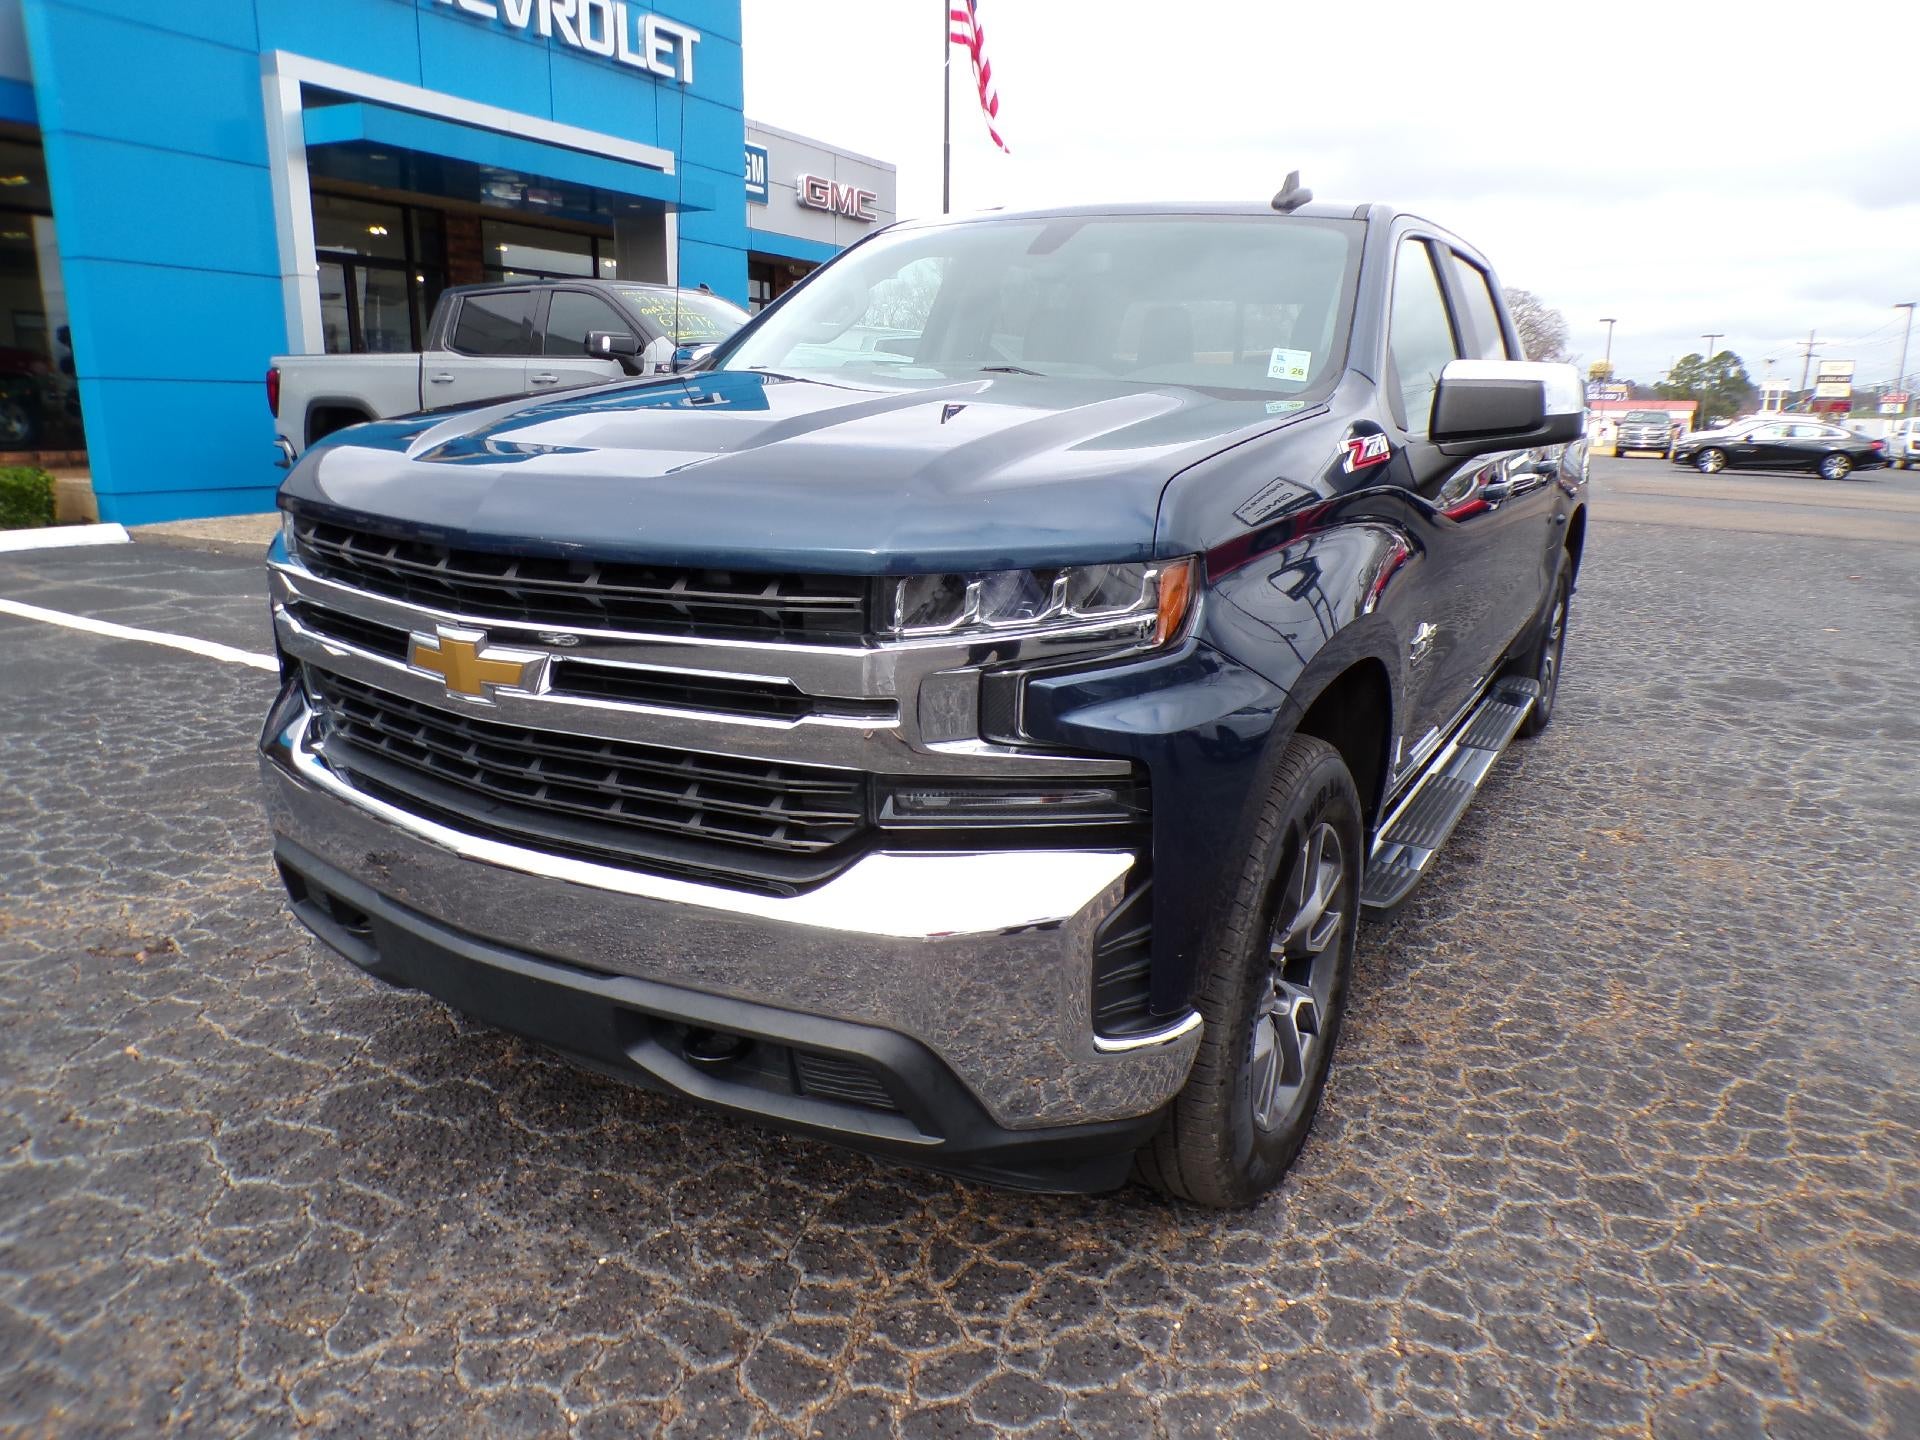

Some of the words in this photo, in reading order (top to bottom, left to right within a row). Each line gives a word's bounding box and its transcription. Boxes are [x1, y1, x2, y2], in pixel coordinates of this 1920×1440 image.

[799, 174, 877, 221] GMC
[1272, 365, 1285, 374] 08
[1291, 367, 1305, 376] 26
